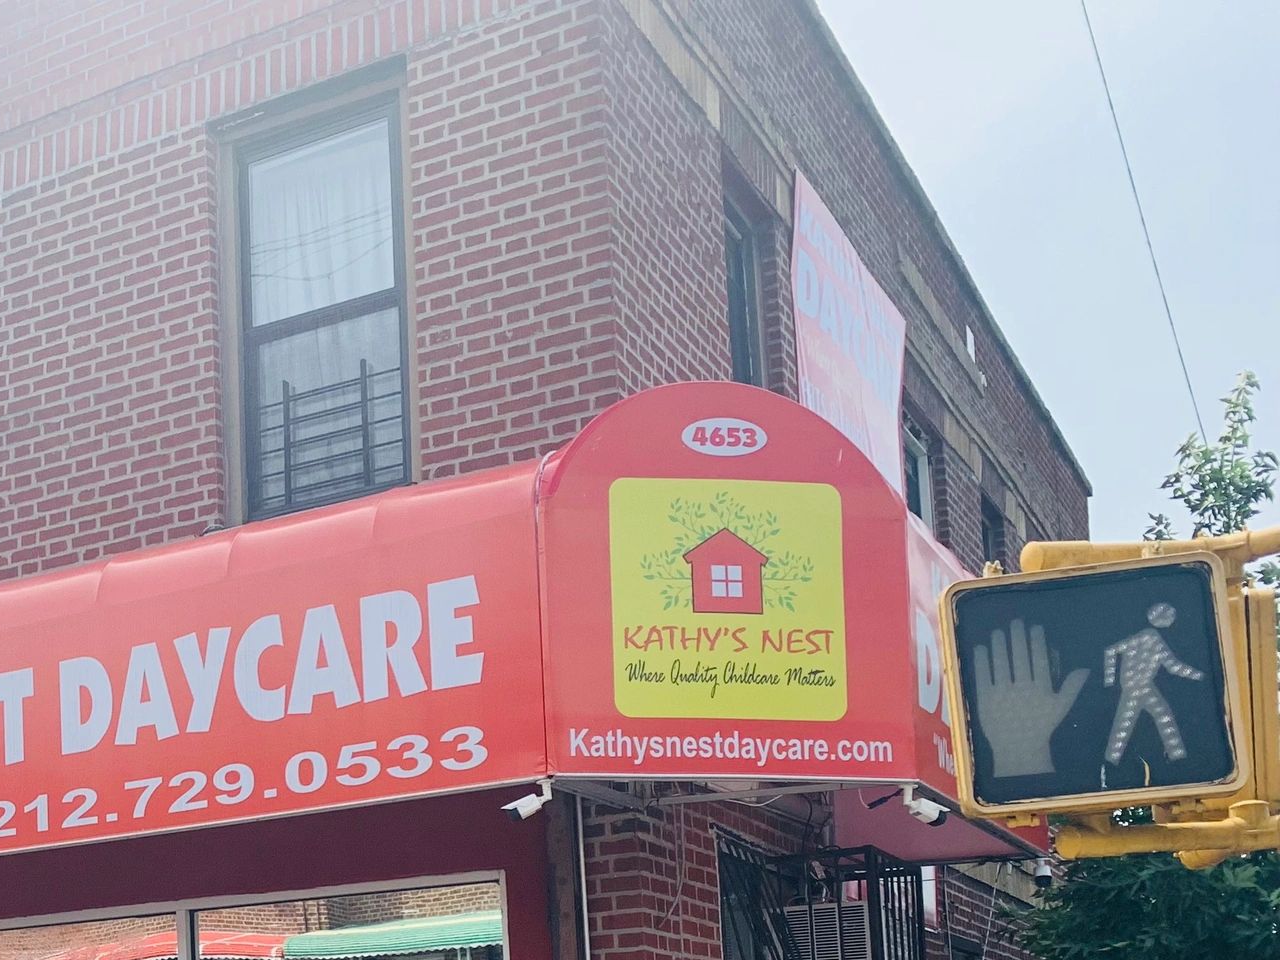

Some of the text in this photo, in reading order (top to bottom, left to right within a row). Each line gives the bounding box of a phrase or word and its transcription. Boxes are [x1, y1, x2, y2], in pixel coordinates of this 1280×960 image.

[691, 426, 759, 449] 4653
[623, 625, 835, 655] KATHY'S NEST
[58, 574, 485, 757] DAYCARE
[625, 658, 837, 699] Where Quality Childcare Matters
[569, 727, 894, 767] Kathysnestdaycare.com
